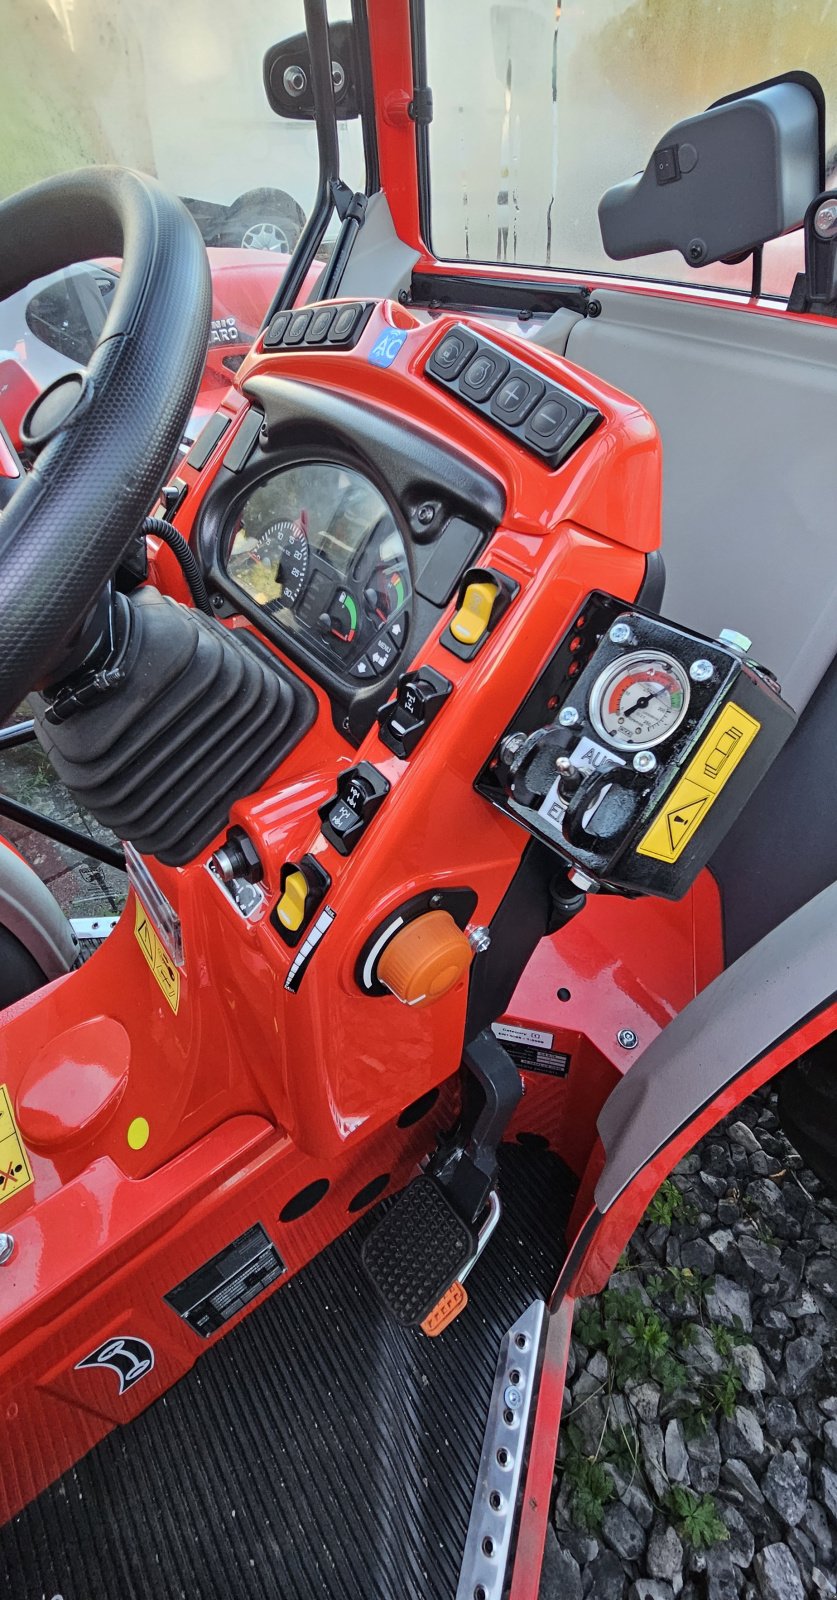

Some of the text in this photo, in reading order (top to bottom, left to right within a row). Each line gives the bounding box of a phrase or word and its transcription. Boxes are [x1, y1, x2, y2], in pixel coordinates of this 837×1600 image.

[293, 550, 303, 561] 20
[291, 567, 301, 577] 25
[283, 587, 293, 598] 30
[378, 640, 391, 653] MENU
